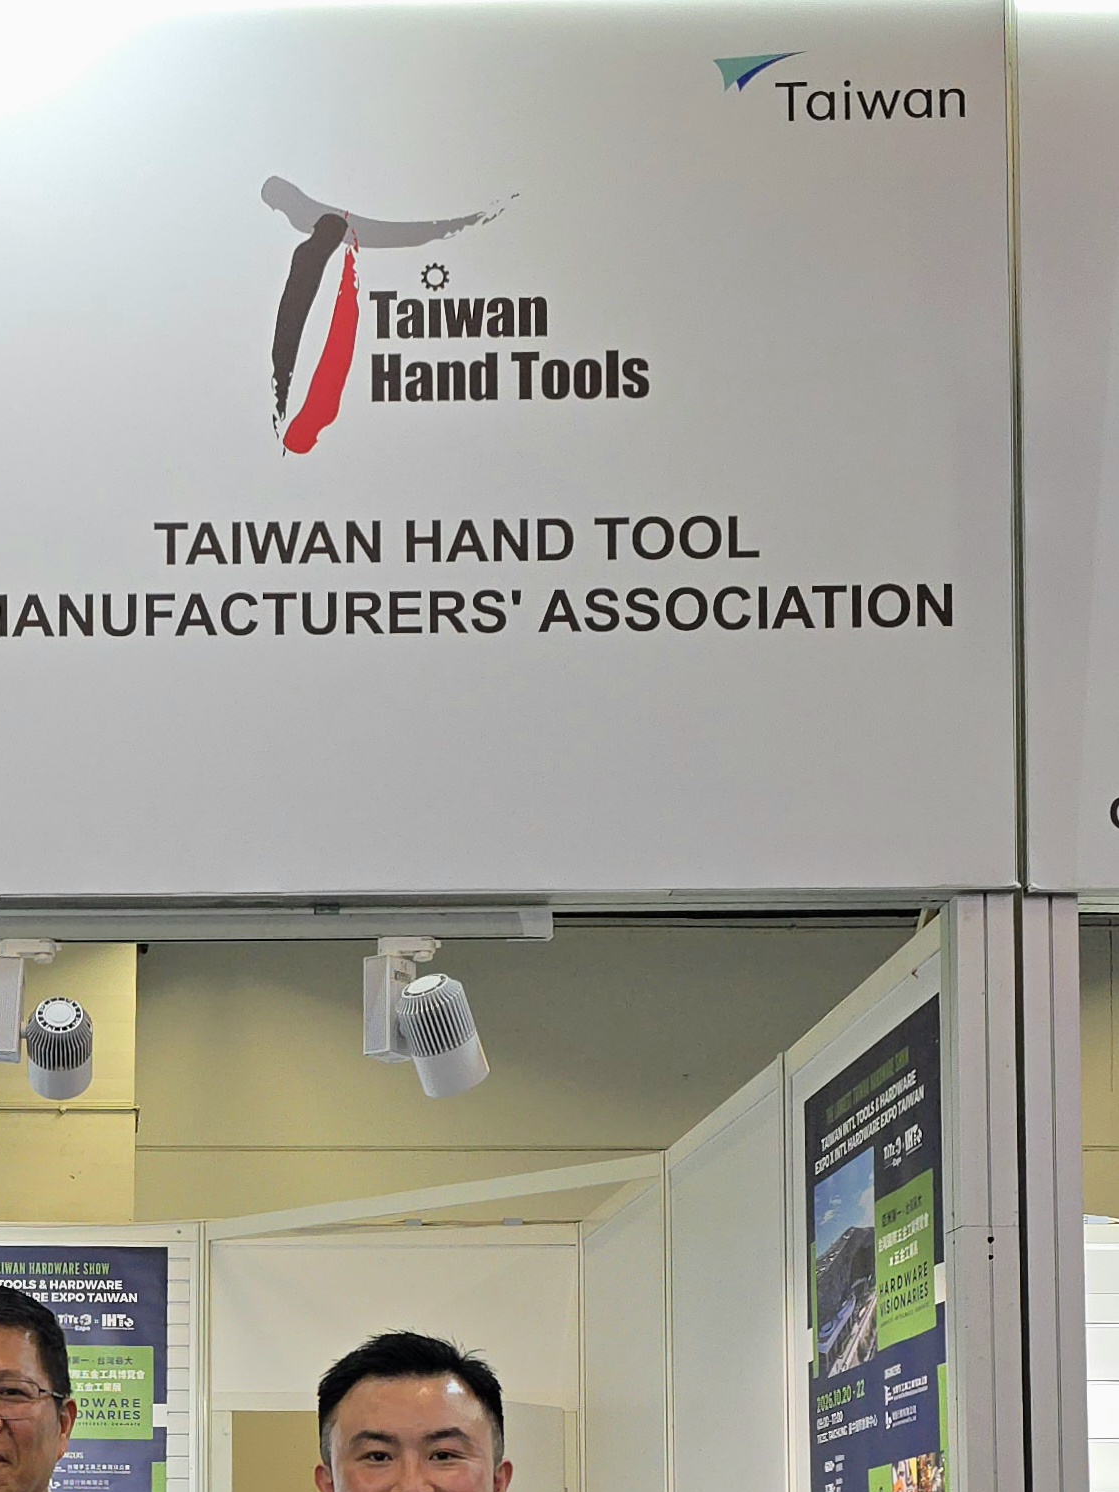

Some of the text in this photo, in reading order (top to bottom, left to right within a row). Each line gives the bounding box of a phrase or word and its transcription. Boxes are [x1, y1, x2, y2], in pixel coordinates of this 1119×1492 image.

[775, 80, 966, 121] Taiwan
[369, 288, 548, 339] Taiwan
[370, 350, 650, 403] Hand Tools
[153, 515, 761, 566] TAIWAN HAND TOOL
[538, 583, 954, 635] ASSOCIATION
[29, 1262, 80, 1275] HARDWARE
[83, 1262, 110, 1276] SHOW
[39, 1279, 48, 1290] &
[49, 1279, 123, 1291] HARDWARE
[879, 1260, 929, 1298] HARDWARE
[51, 1292, 85, 1303] EXPO
[86, 1292, 138, 1303] TAIWAN
[880, 1281, 929, 1318] VISIONARIES
[77, 1410, 141, 1420] ONARIES
[80, 1398, 141, 1408] DWARE
